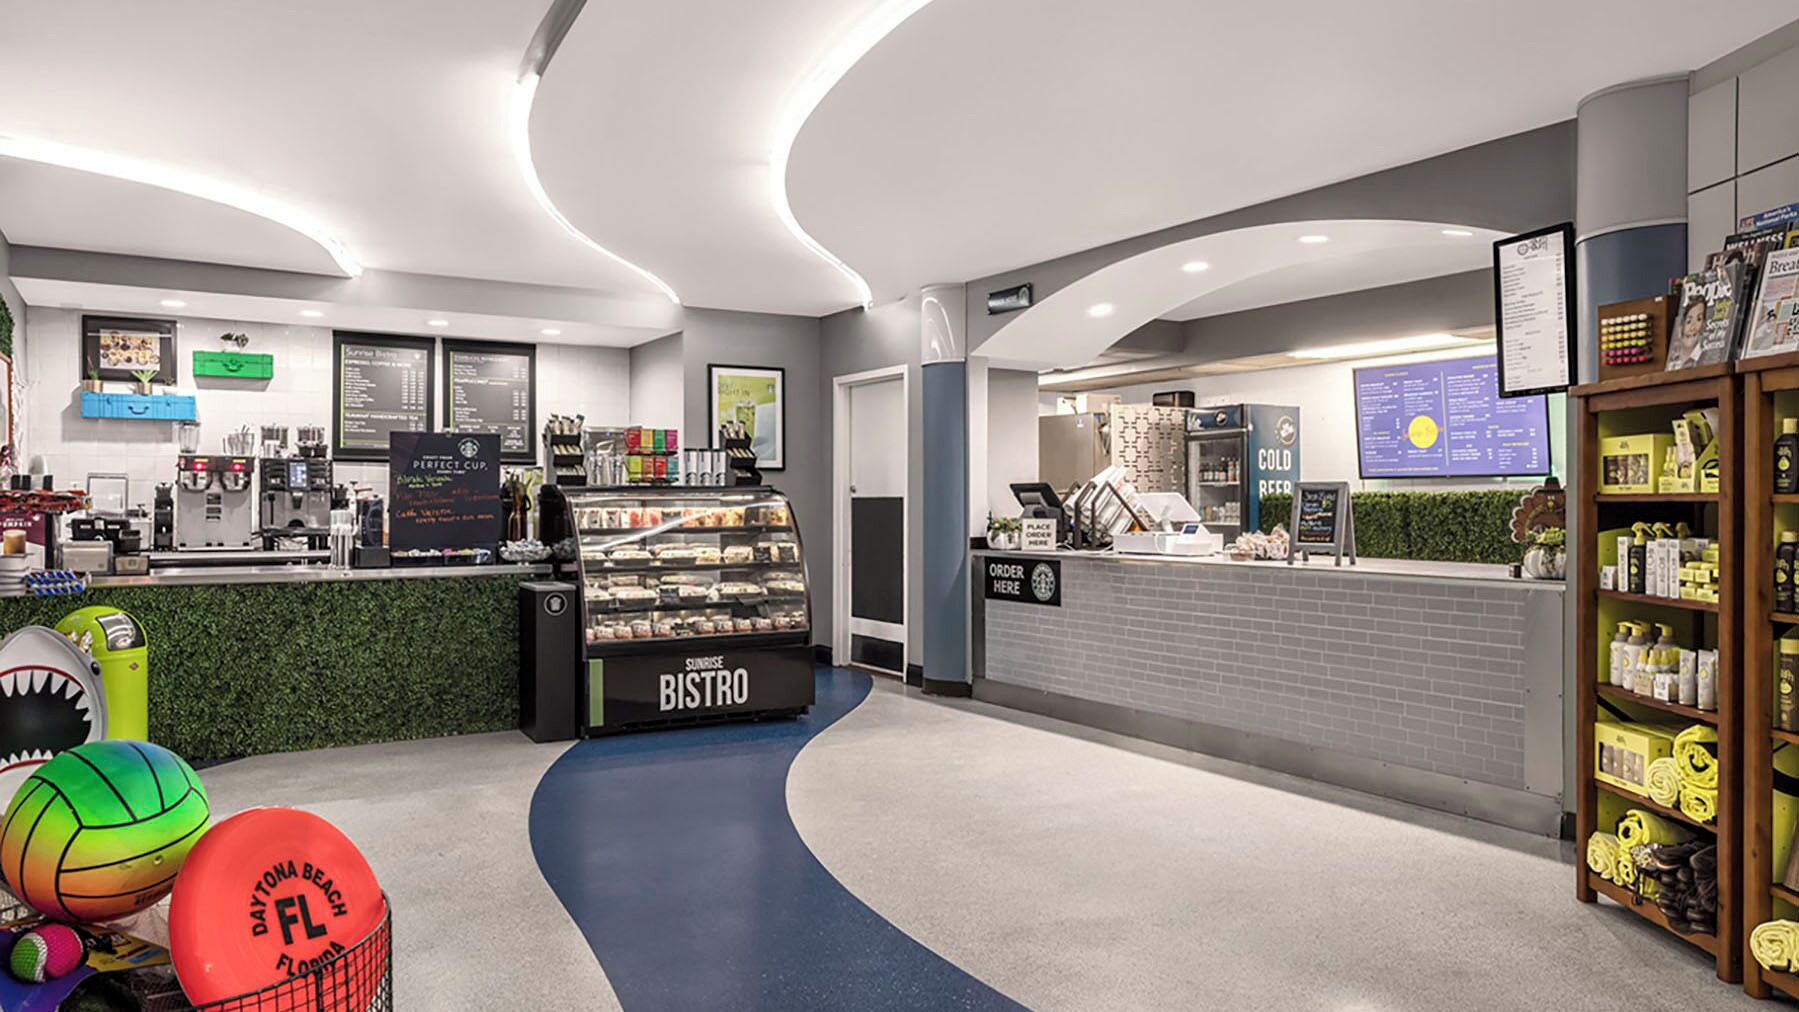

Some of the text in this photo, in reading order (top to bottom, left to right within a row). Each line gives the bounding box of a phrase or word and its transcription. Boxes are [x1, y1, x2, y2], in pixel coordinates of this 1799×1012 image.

[1763, 207, 1791, 218] America's
[1781, 211, 1797, 219] Parks
[413, 460, 459, 470] PERFECT
[1258, 448, 1292, 470] COLD
[989, 563, 1024, 579] ORDER
[993, 579, 1020, 595] HERE
[685, 656, 724, 671] SUNRISE
[660, 667, 748, 711] BISTRO
[250, 860, 347, 937] DAYTONA BEACH
[274, 894, 327, 945] FL
